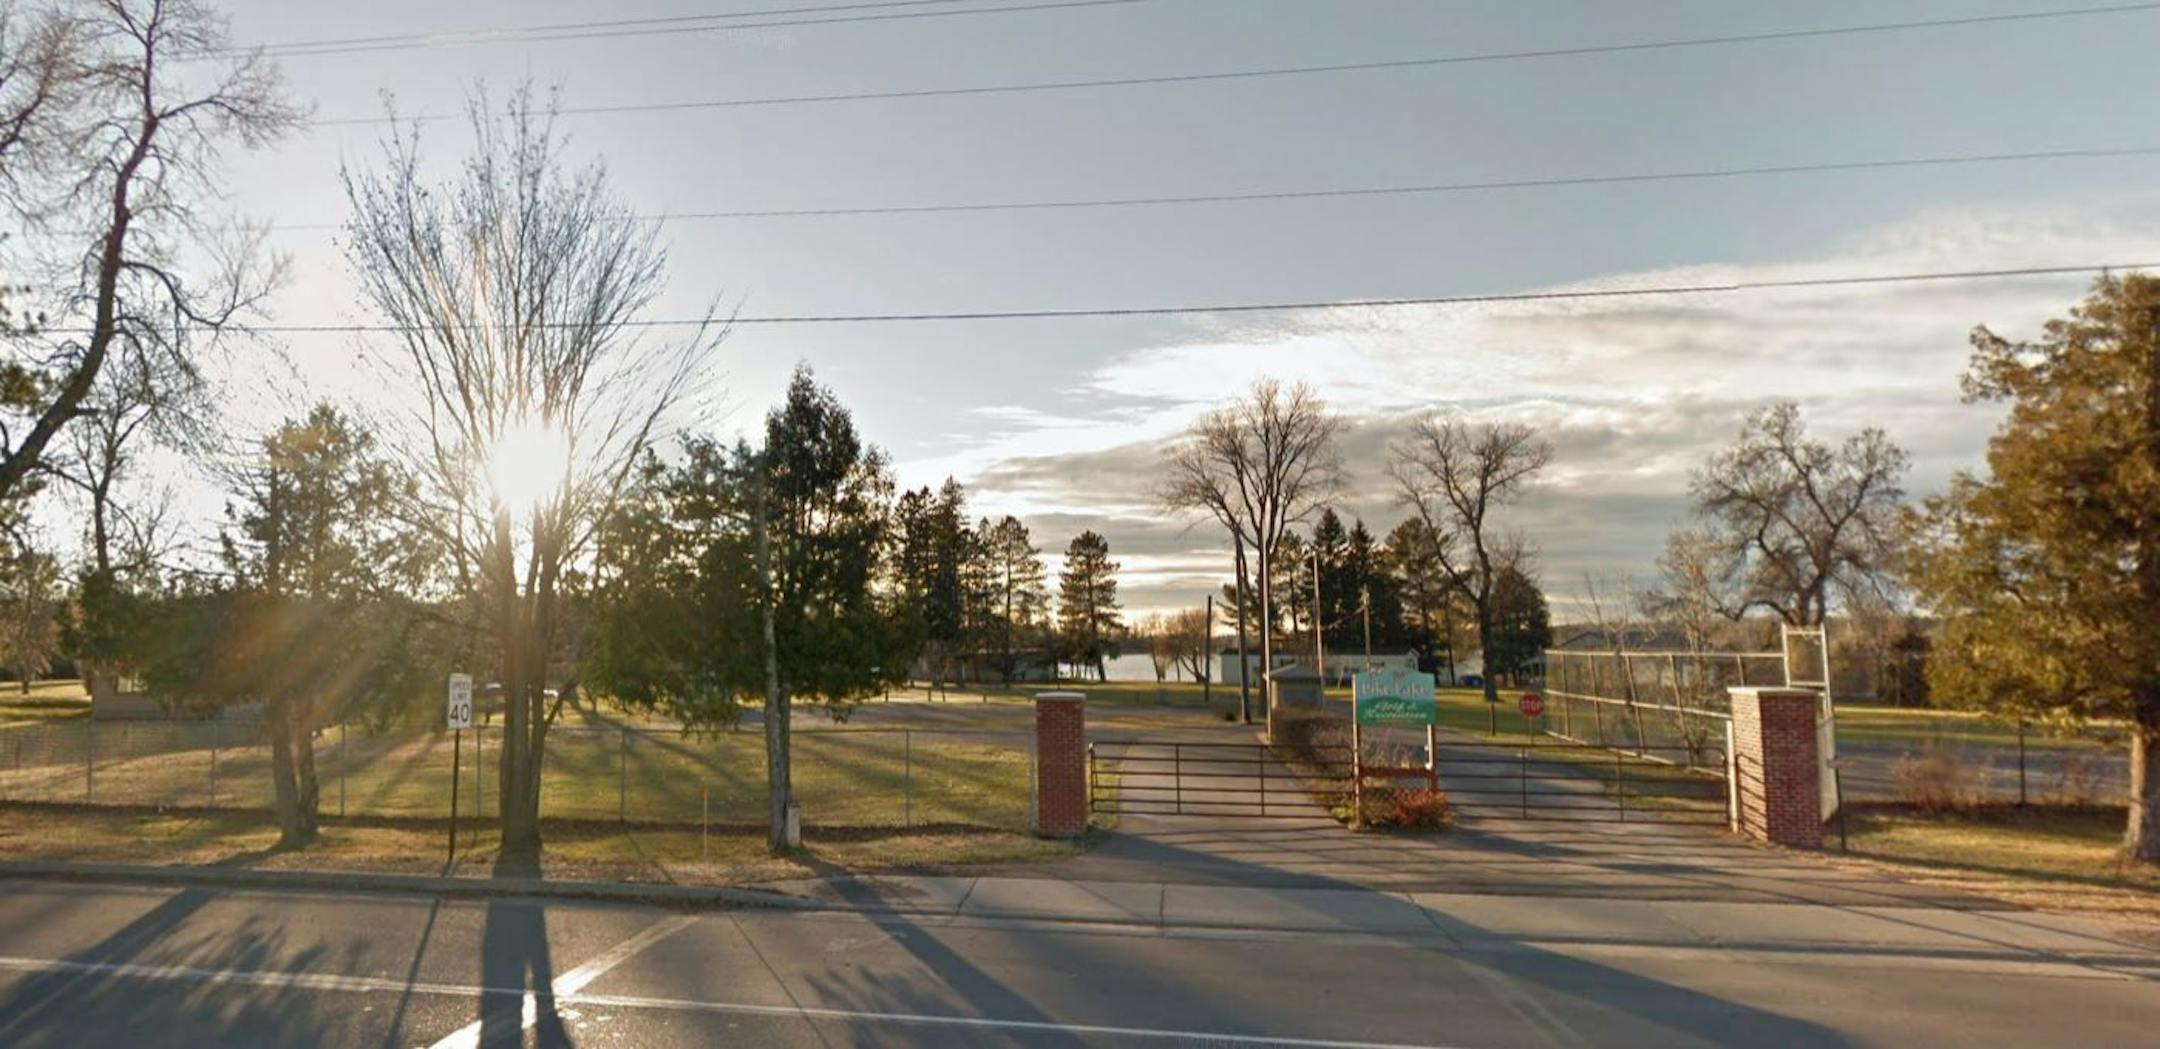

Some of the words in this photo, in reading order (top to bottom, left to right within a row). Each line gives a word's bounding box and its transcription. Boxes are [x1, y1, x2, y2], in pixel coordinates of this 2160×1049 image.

[1395, 681, 1429, 696] Lake
[450, 704, 470, 722] 40
[1521, 700, 1543, 711] STOP
